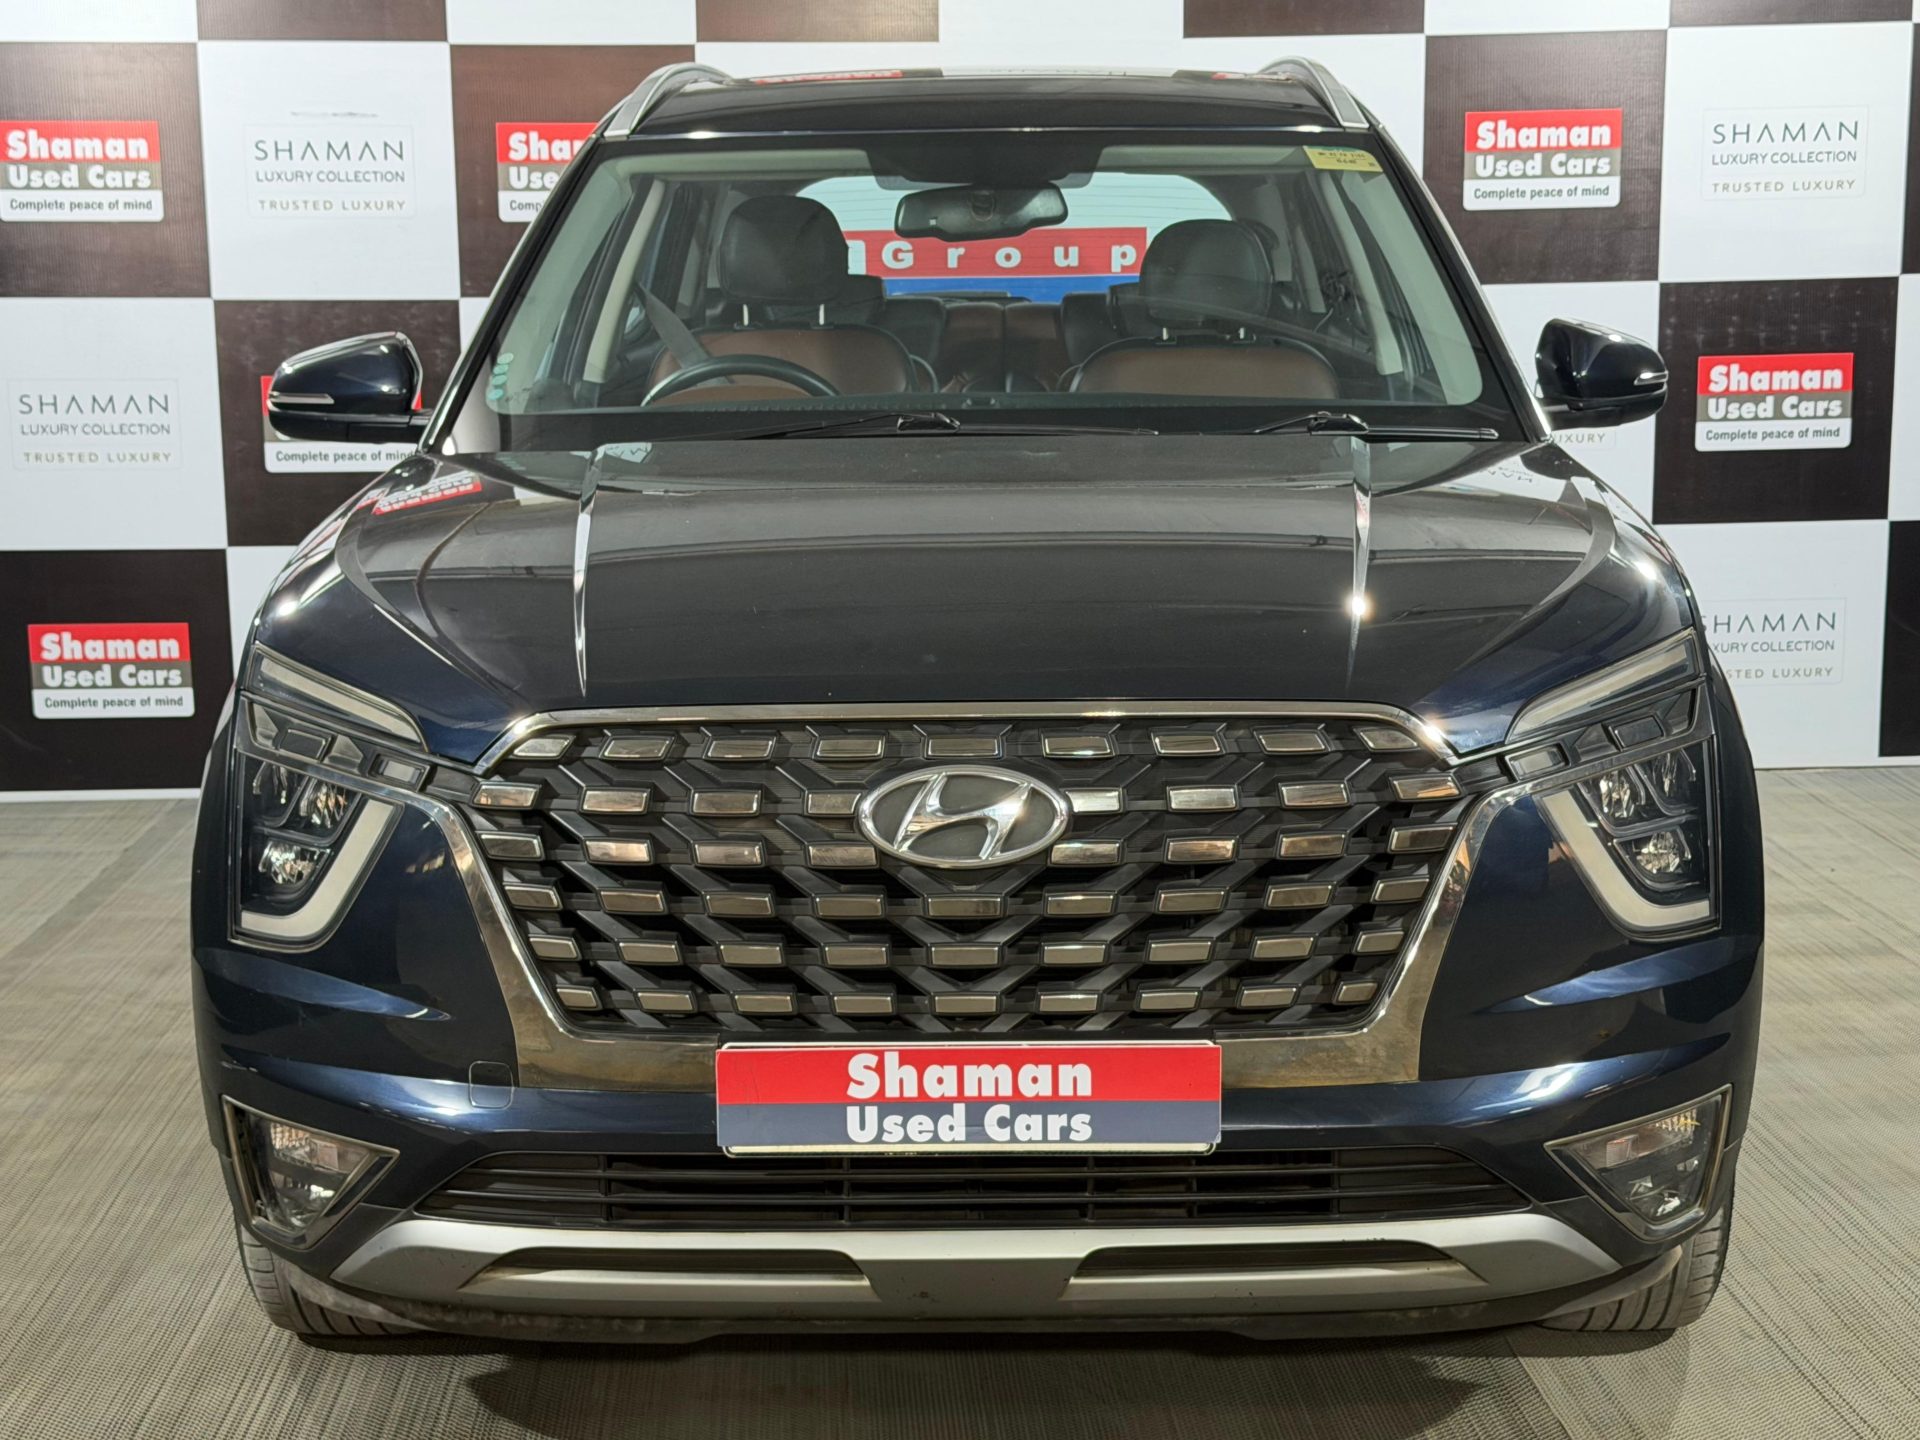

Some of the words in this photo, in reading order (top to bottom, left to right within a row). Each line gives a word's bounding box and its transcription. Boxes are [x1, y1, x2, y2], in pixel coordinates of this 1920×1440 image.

[1476, 119, 1611, 149] Shaman
[1712, 121, 1858, 144] SHAMAN
[6, 129, 149, 160] Shaman
[255, 140, 404, 161] SHAMAN
[1475, 152, 1542, 178] Used
[1551, 153, 1611, 176] Cars
[1712, 153, 1768, 166] LUXURY
[1770, 151, 1857, 164] COLLECTION
[8, 164, 80, 188] Used
[88, 165, 151, 188] Cars
[256, 171, 313, 182] LUXURY
[316, 171, 405, 182] COLLECTION
[1712, 181, 1784, 193] TRUSTED
[1793, 179, 1855, 191] LUXURY
[1474, 187, 1526, 200] Complete
[1530, 188, 1562, 199] peace
[1567, 186, 1578, 196] of
[1581, 185, 1610, 196] mind
[10, 199, 65, 212] Complete
[70, 201, 104, 212] peace
[108, 199, 120, 210] of
[123, 199, 152, 210] mind
[259, 200, 333, 211] TRUSTED
[342, 200, 405, 211] LUXURY
[881, 240, 1137, 273] Group
[1708, 363, 1843, 392] Shaman
[19, 394, 169, 415] SHAMAN
[1708, 395, 1775, 419] Used
[1782, 395, 1842, 418] Cars
[21, 423, 78, 436] LUXURY
[82, 423, 170, 435] COLLECTION
[1706, 429, 1757, 442] Complete
[1761, 430, 1794, 441] peace
[1798, 428, 1809, 438] of
[1812, 427, 1840, 438] mind
[24, 452, 99, 464] TRUSTED
[107, 452, 171, 463] LUXURY
[276, 450, 329, 463] Complete
[333, 452, 367, 463] peace
[371, 450, 383, 461] of
[40, 631, 180, 661] Shaman
[1751, 640, 1835, 652] COLLECTION
[42, 664, 112, 687] Used
[119, 664, 182, 687] Cars
[1773, 667, 1833, 678] LUXURY
[45, 697, 98, 709] Complete
[103, 699, 136, 709] peace
[140, 696, 151, 706] of
[155, 696, 183, 706] mind
[846, 1051, 1092, 1100] Shaman
[846, 1103, 966, 1143] Used
[984, 1104, 1092, 1143] Cars
